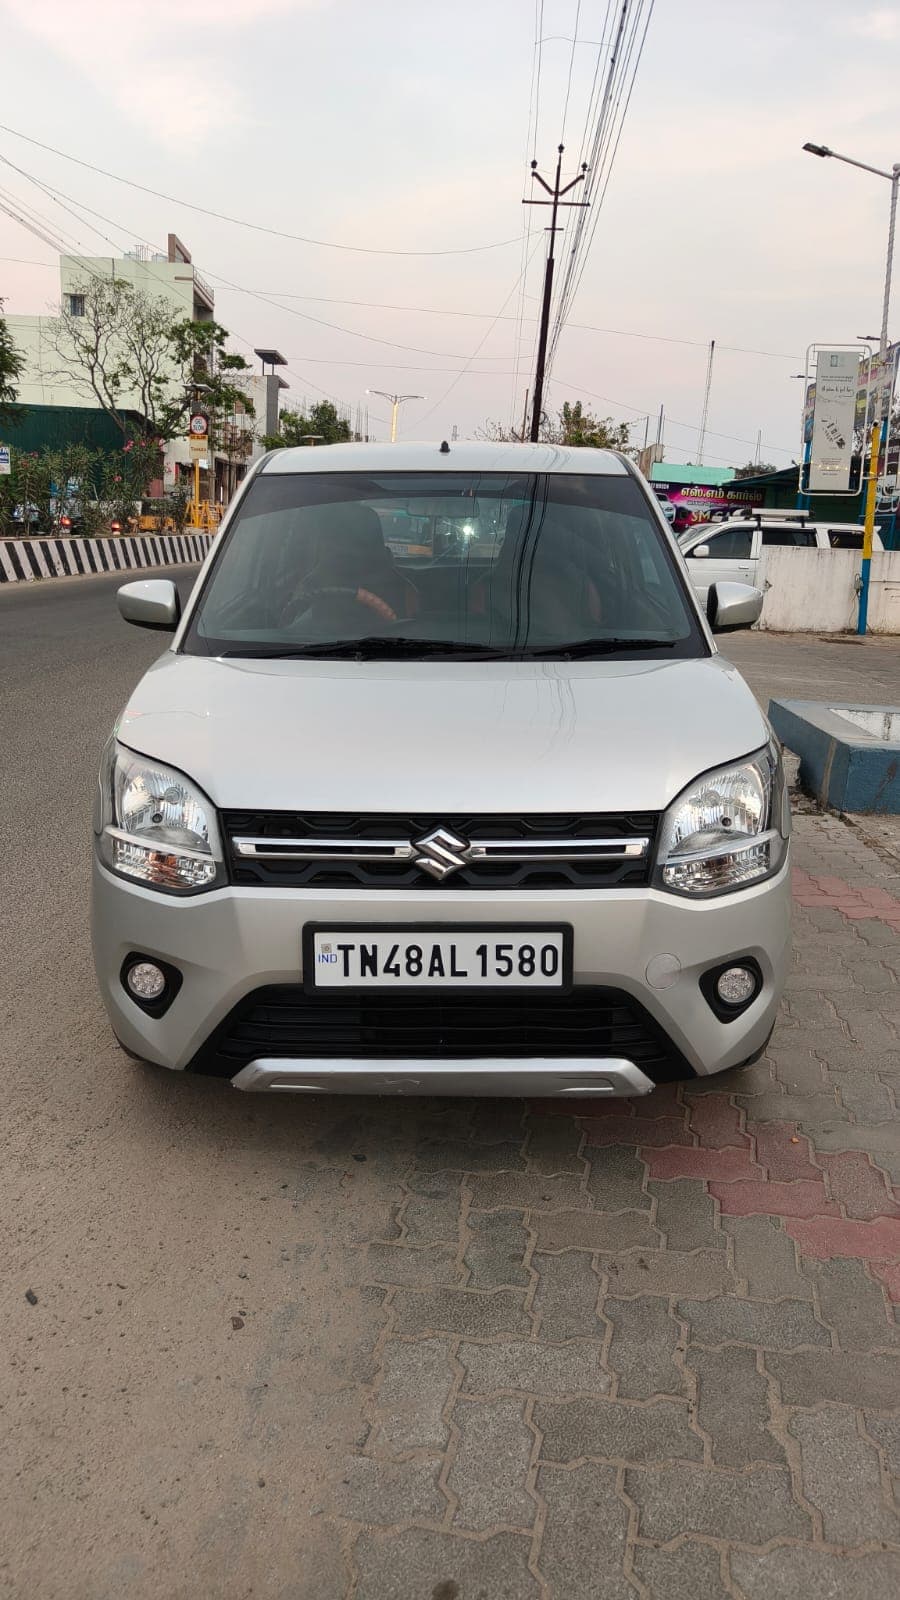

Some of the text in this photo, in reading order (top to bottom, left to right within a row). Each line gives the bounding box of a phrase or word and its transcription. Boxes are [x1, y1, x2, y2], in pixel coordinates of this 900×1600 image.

[691, 510, 711, 522] SM
[318, 953, 337, 964] IND
[337, 944, 559, 977] TN48AL1580
